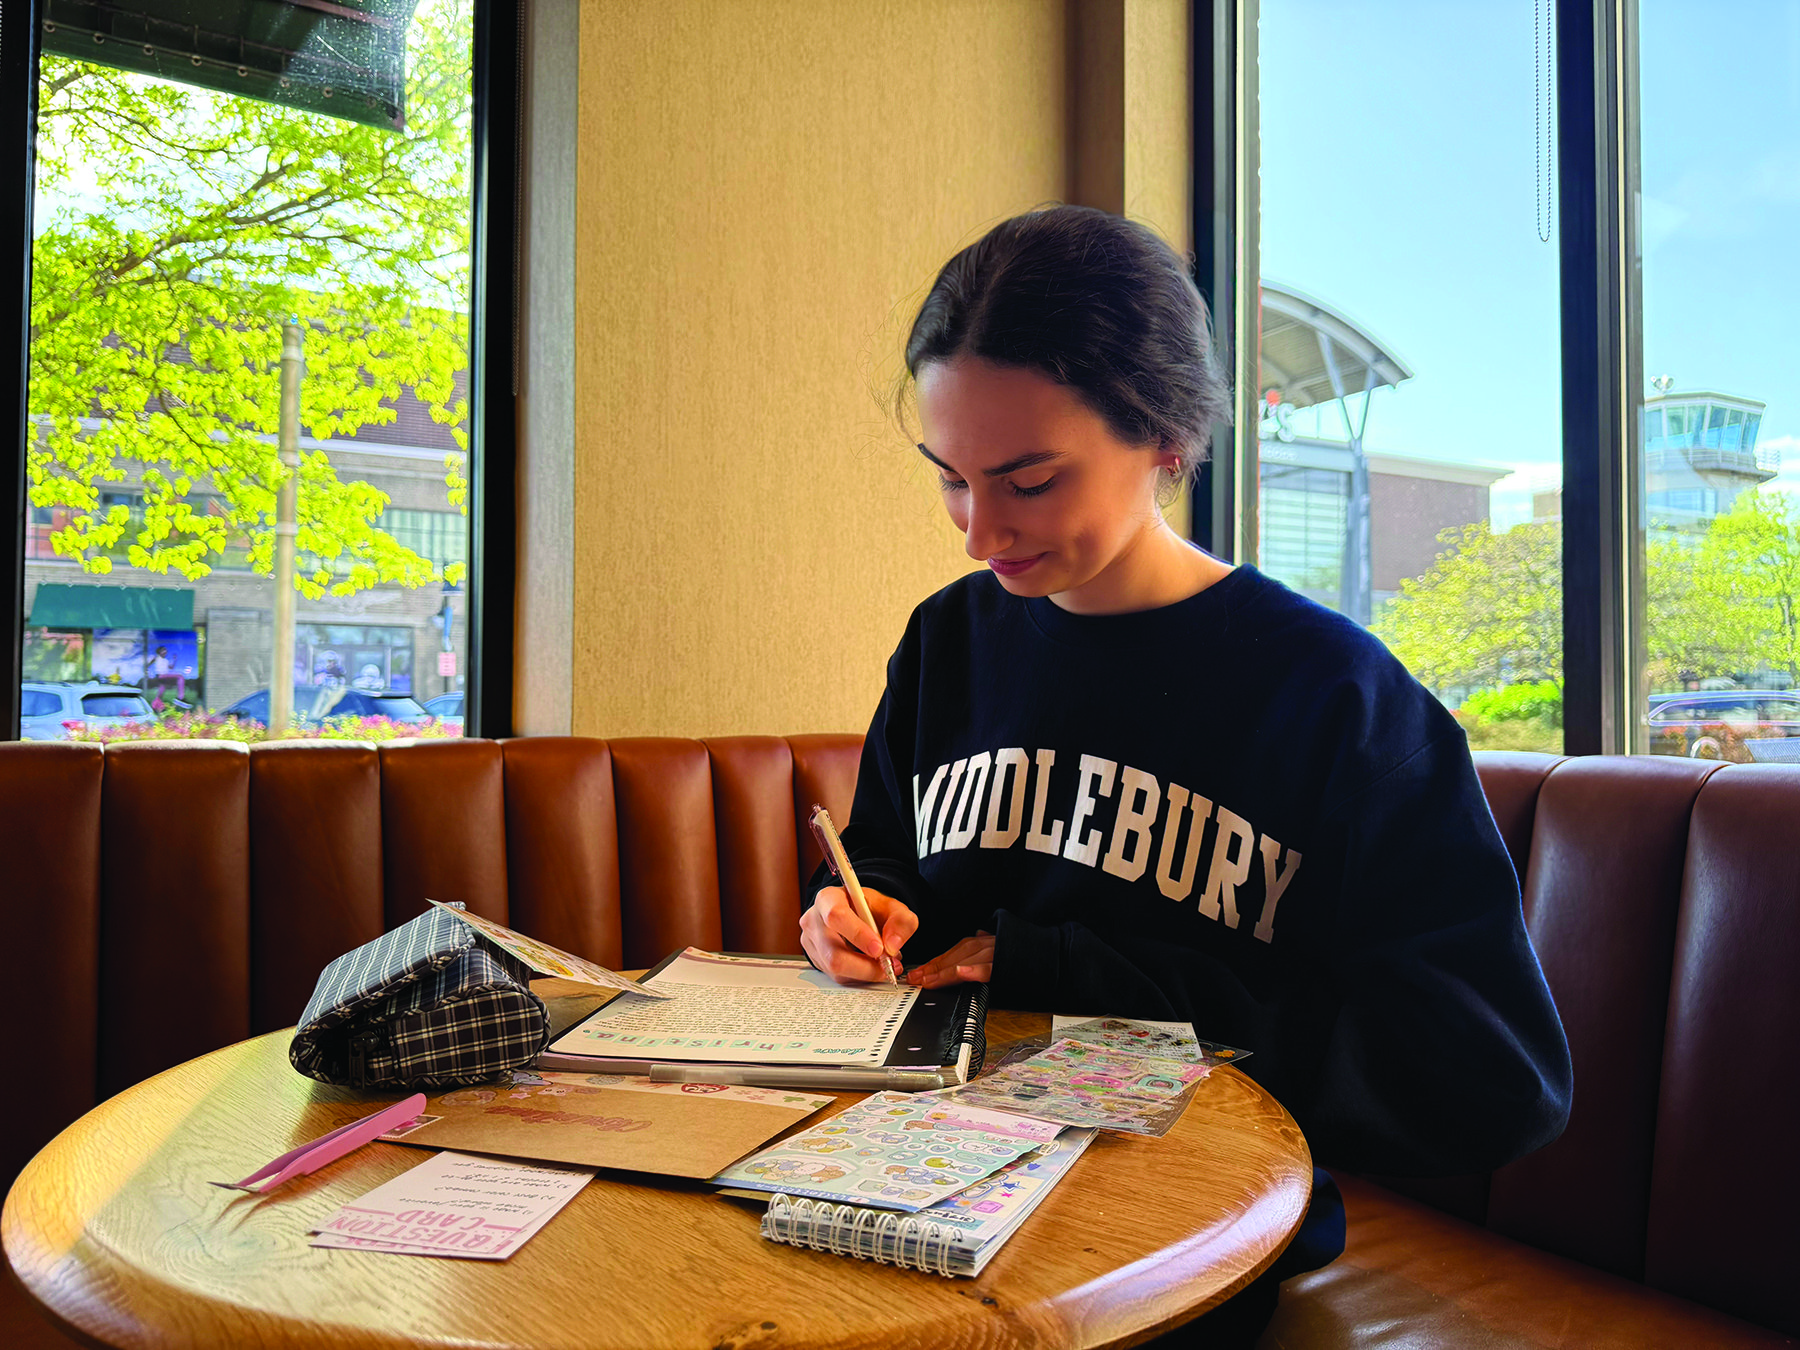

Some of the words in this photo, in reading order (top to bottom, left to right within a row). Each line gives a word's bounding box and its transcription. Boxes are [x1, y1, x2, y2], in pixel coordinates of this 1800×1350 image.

[913, 747, 1302, 944] MIDDLEBURY
[327, 1215, 492, 1249] QUESTION
[395, 1209, 486, 1231] CARD
